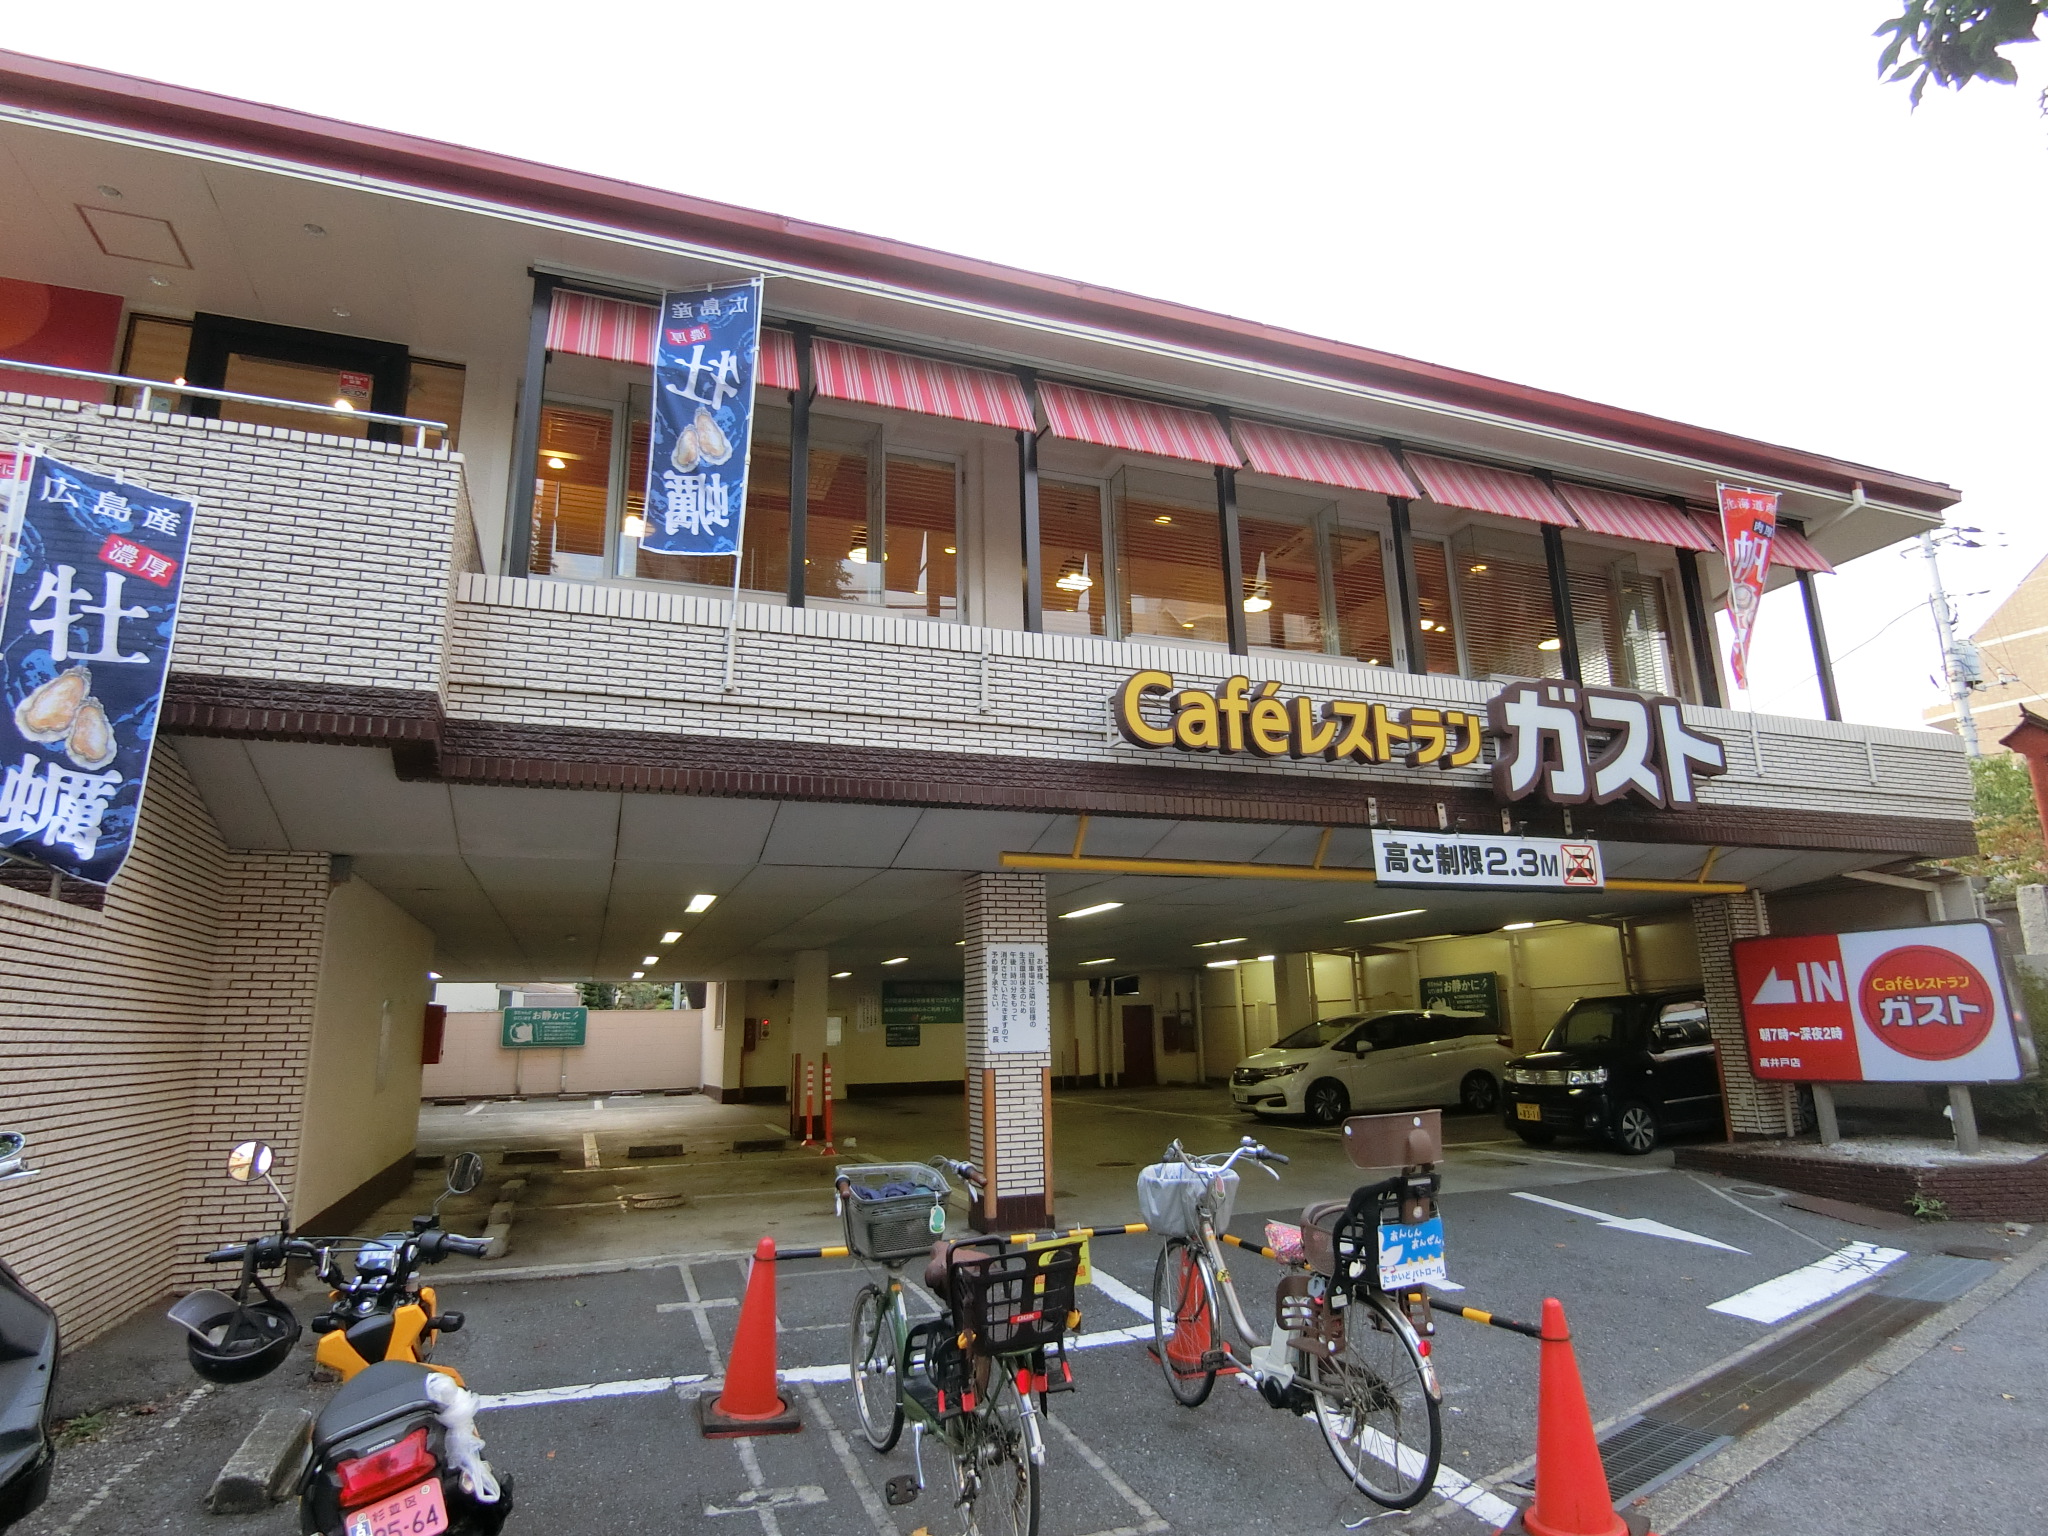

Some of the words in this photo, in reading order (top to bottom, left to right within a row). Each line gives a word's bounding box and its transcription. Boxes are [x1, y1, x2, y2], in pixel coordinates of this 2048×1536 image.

[40, 475, 182, 536] 広島産
[108, 540, 172, 578] 濃厚
[1504, 684, 1723, 802] ガスト
[1382, 840, 1559, 877] 高さ制限2.3M
[1797, 960, 1844, 1003] IN
[1879, 995, 1980, 1026] ガスト
[992, 1026, 999, 1043] 店長
[1760, 1057, 1801, 1068] 高井戸店
[1390, 1228, 1422, 1242] あんしん
[1383, 1266, 1444, 1284] たかいどパトロール
[372, 1495, 417, 1522] 杉並区
